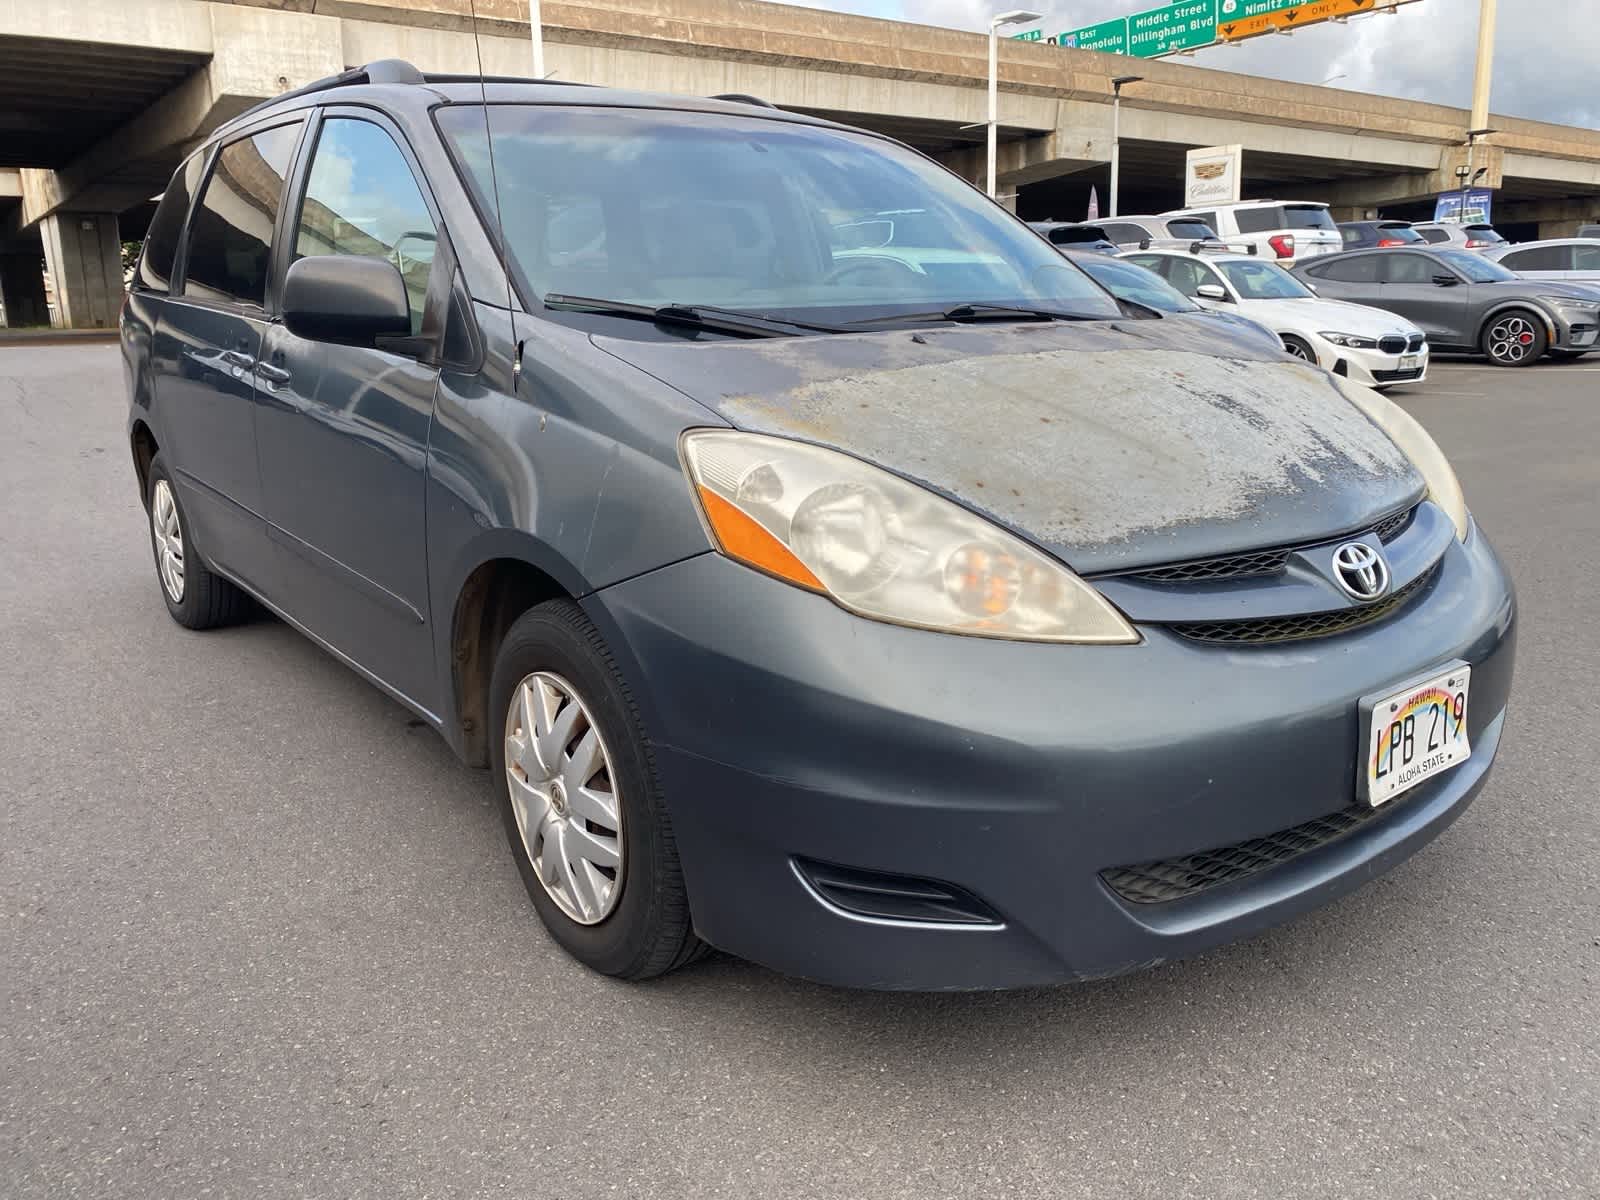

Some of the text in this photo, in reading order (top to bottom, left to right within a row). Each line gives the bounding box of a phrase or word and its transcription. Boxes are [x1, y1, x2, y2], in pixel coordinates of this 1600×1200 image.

[1136, 2, 1207, 29] Middle Street
[1245, 0, 1283, 17] Nimitz
[1311, 3, 1338, 16] ONLY
[1080, 29, 1097, 40] EAST
[1131, 16, 1214, 45] Dillingham Blvd
[1408, 687, 1438, 707] HAWAII
[1376, 691, 1465, 780] LPB 219
[1398, 753, 1445, 786] ALOHA STATE
